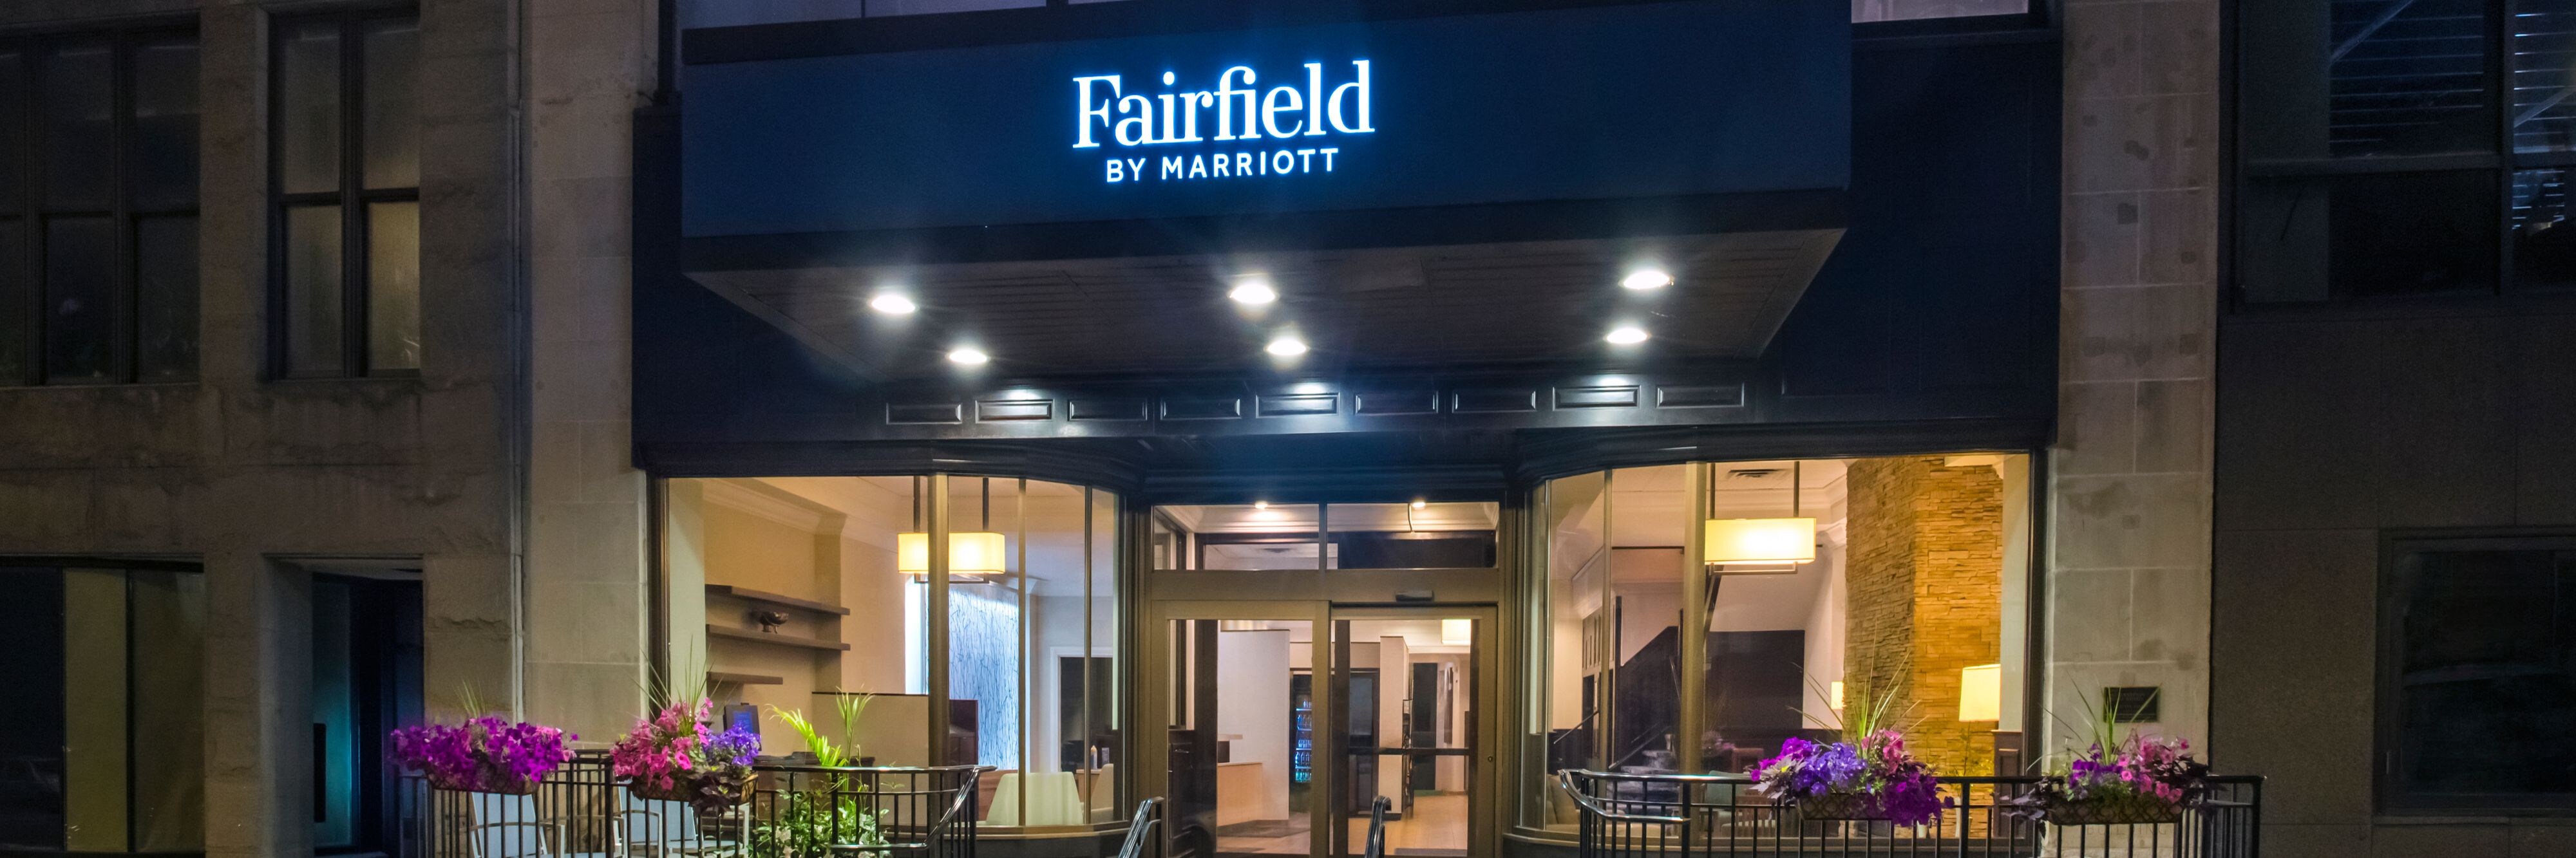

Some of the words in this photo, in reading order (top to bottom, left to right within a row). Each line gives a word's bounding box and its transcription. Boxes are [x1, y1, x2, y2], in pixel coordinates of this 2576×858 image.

[1072, 59, 1376, 148] Fairfield
[1106, 158, 1146, 183] BY
[1161, 147, 1339, 180] MARRIOTT
[2087, 823, 2167, 835] BUILING
